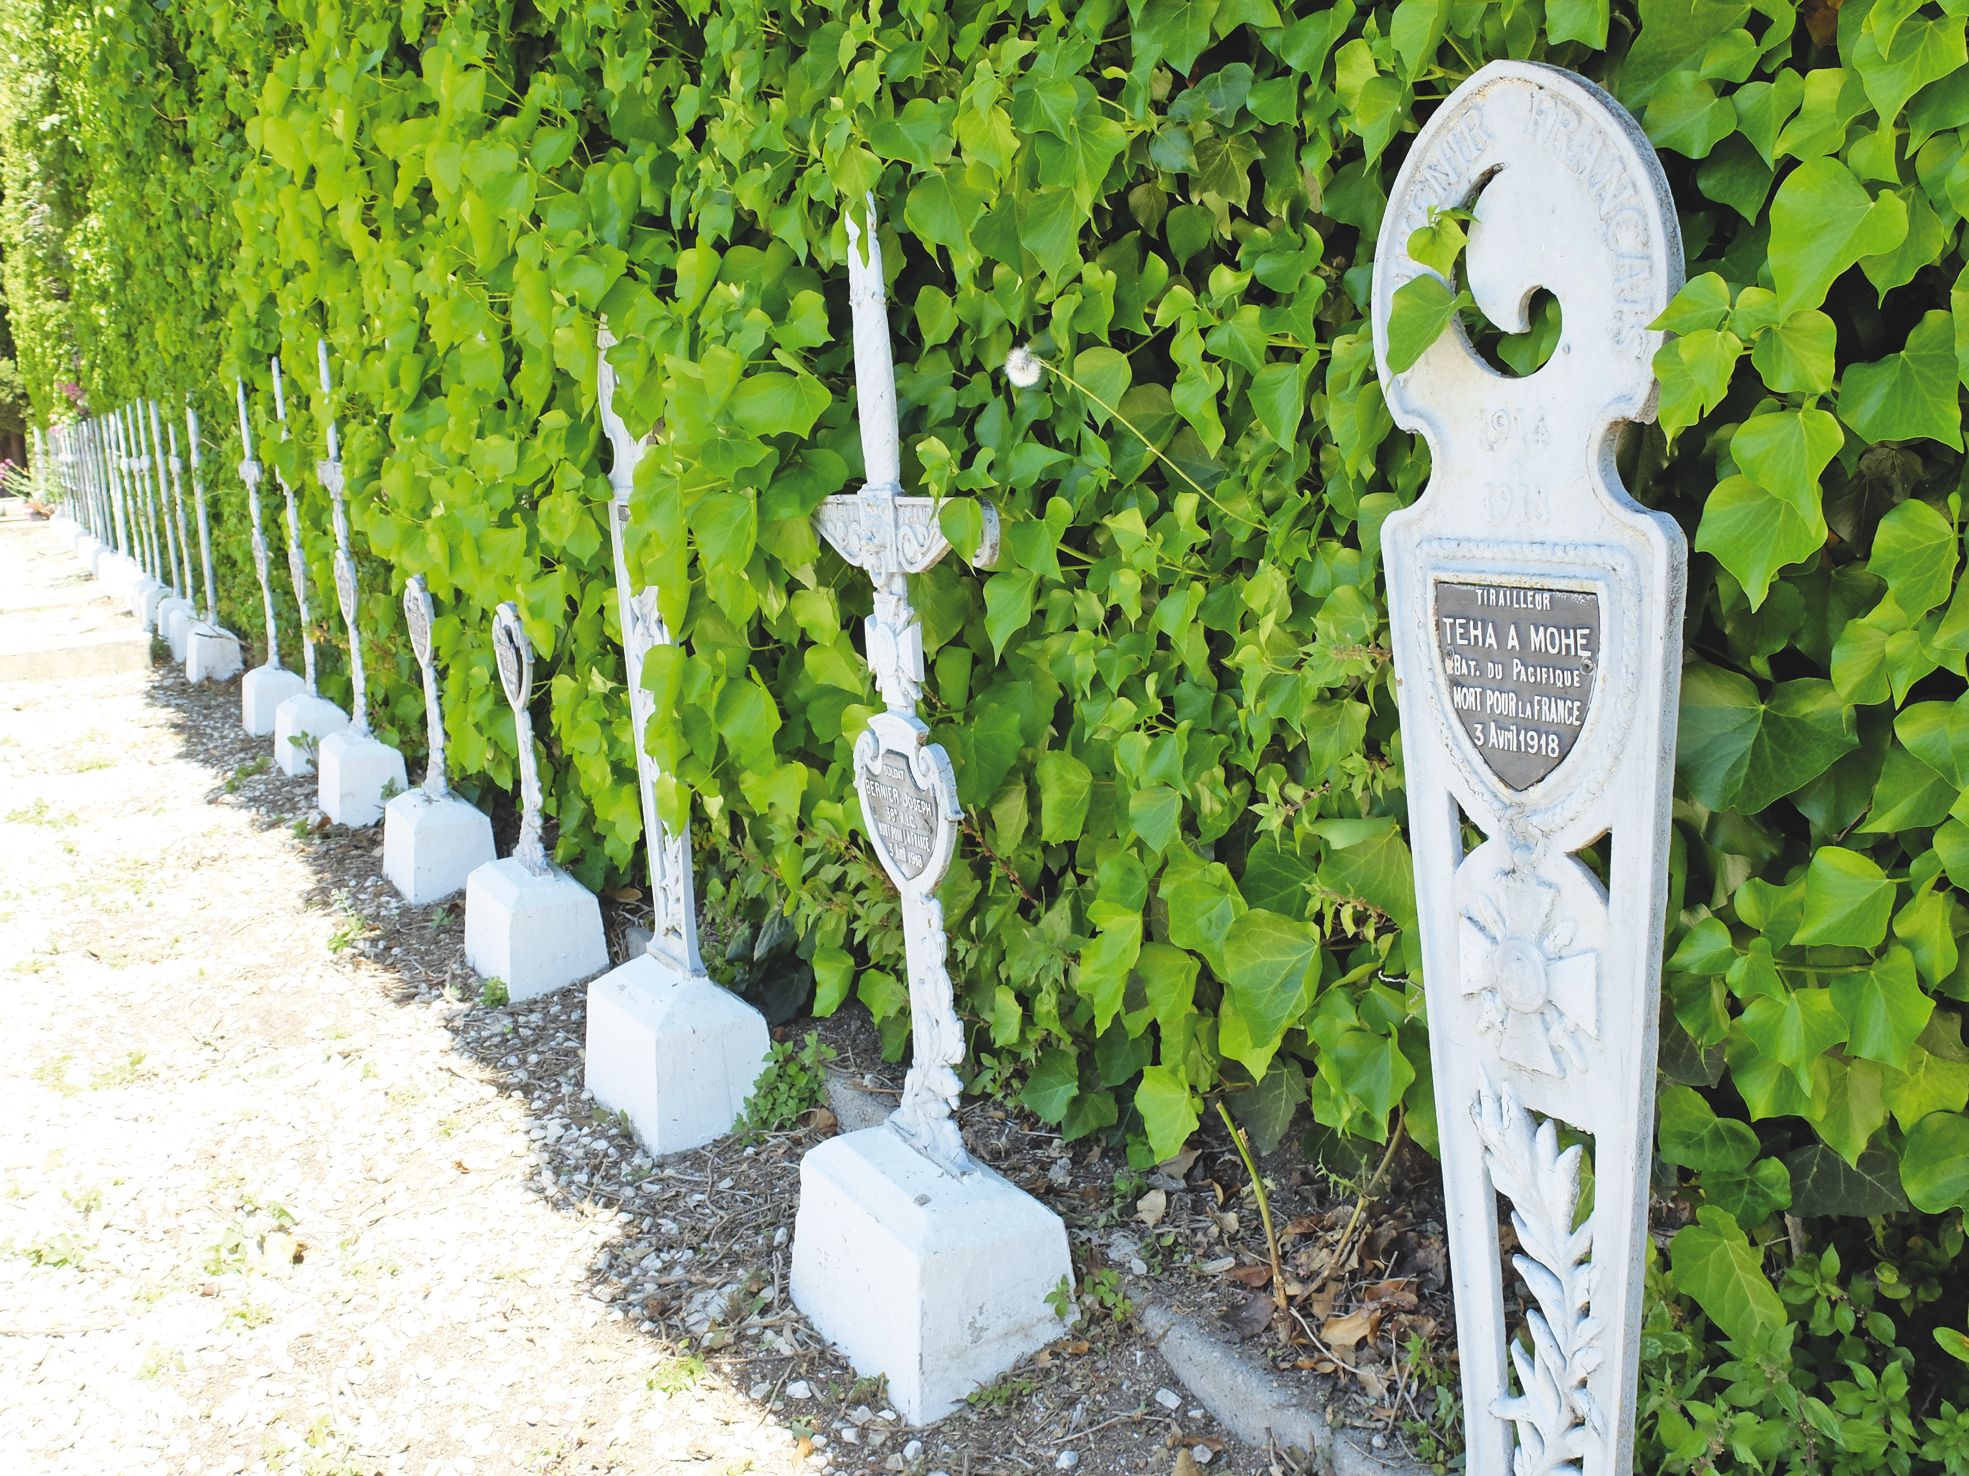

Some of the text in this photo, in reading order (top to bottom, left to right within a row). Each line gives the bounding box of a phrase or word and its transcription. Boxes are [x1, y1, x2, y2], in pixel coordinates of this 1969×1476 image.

[1475, 588, 1551, 611] TIRAILLEUR
[1442, 617, 1592, 657] TEHA A MOHE
[1487, 661, 1503, 680] DU
[1512, 658, 1581, 689] PACIFIQUE
[1453, 686, 1582, 726] MORT POUR LA FRANCE
[1473, 721, 1560, 758] 3 Avril 1918
[883, 764, 904, 780] SOLDAT
[902, 792, 932, 816] JOSEPH
